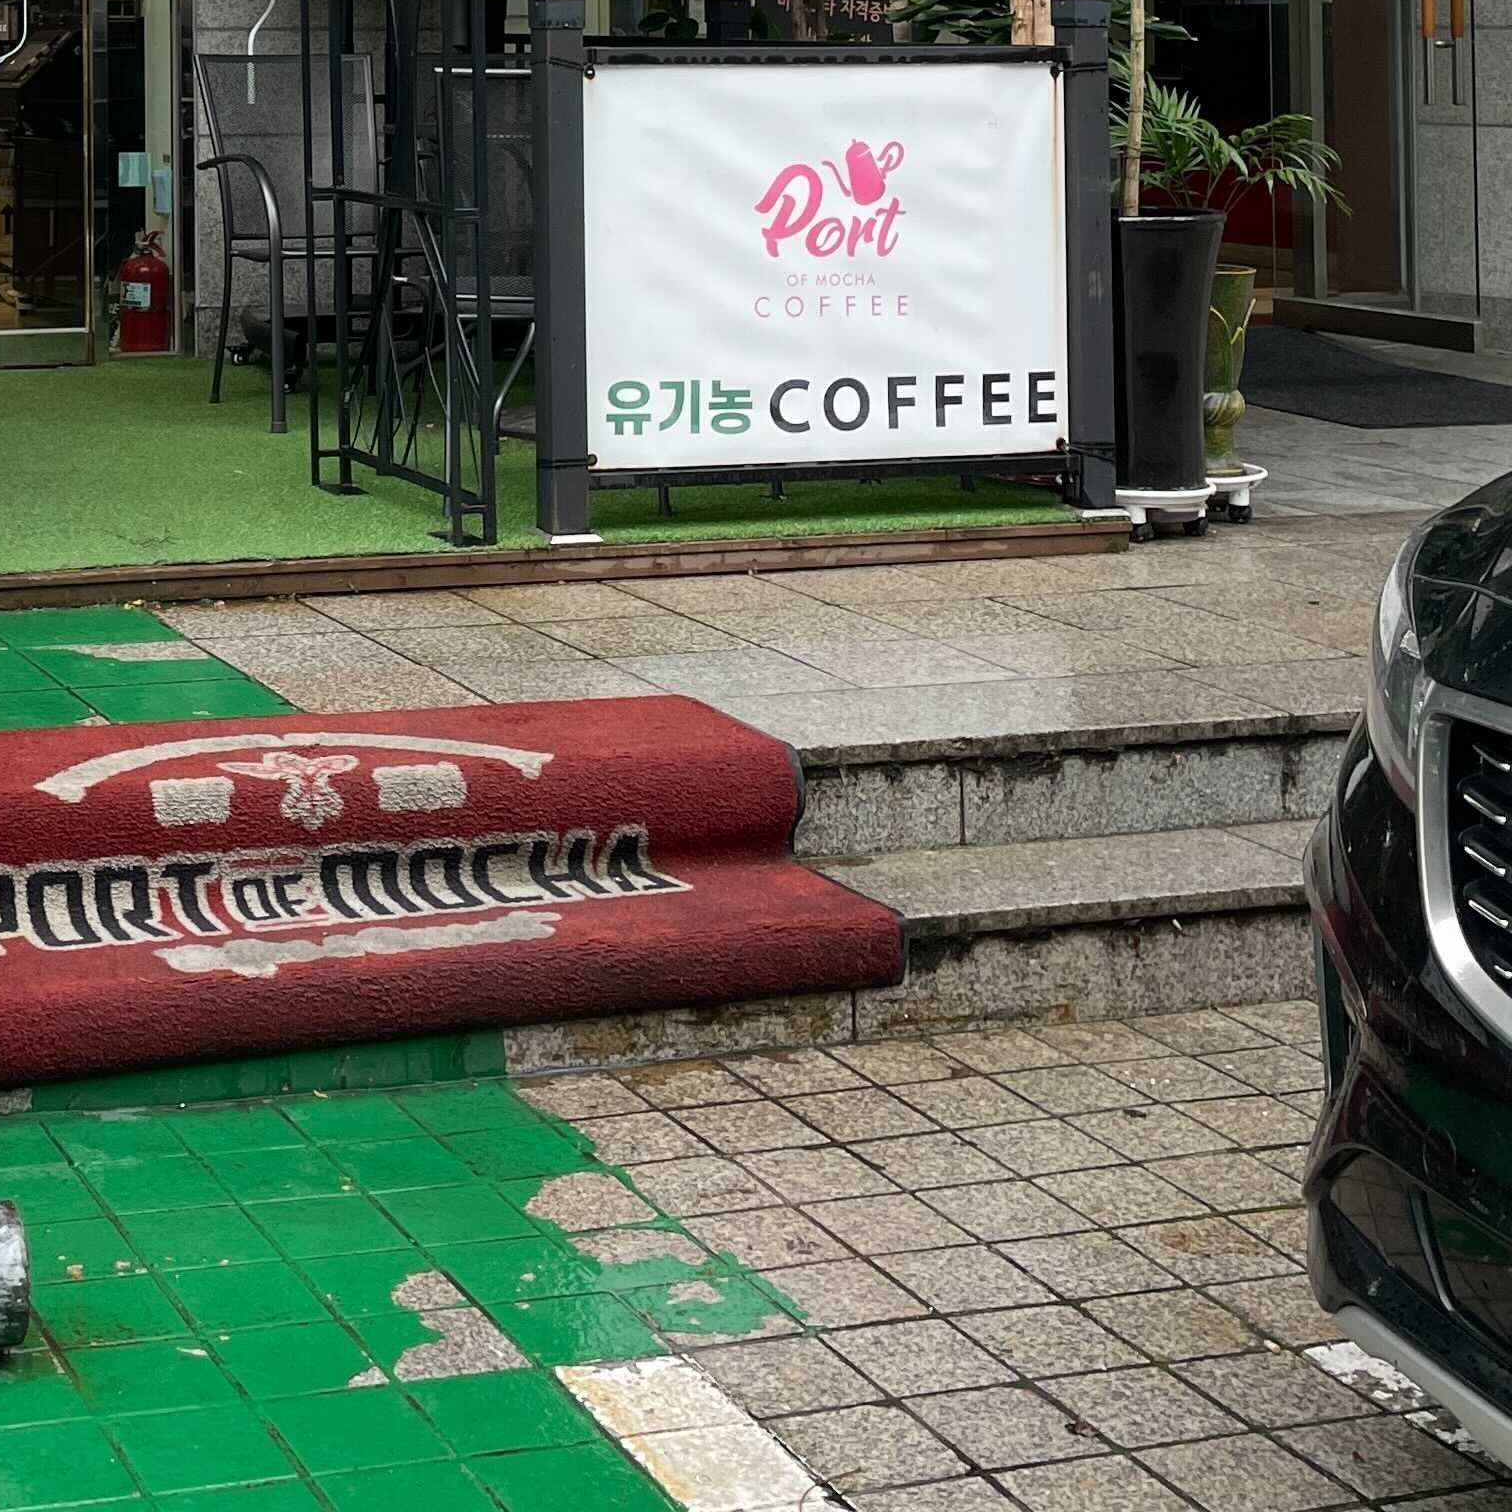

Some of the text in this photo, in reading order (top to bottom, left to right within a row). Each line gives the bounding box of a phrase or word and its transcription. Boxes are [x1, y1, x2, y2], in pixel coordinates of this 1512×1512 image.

[754, 164, 906, 257] Port
[754, 295, 909, 318] COFFEE
[787, 274, 876, 286] OF MOCHA
[605, 371, 1058, 435] 유기농 COFFEE
[238, 873, 306, 922] OF
[318, 833, 671, 919] MOCHA
